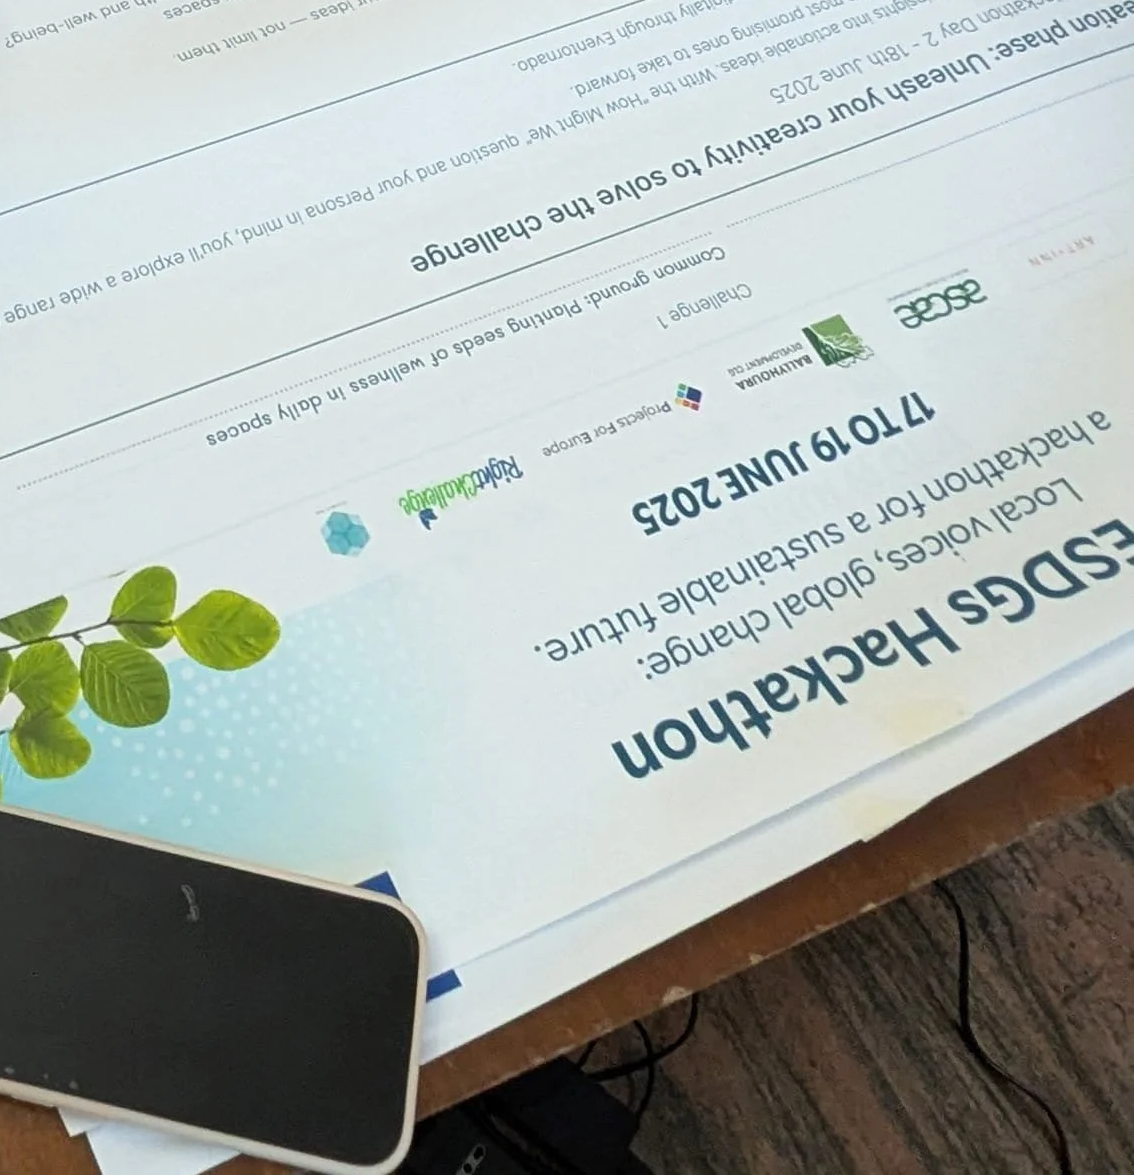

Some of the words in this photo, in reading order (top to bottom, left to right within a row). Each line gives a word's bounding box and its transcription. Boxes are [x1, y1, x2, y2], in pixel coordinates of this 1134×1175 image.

[99, 0, 131, 20] and
[615, 10, 678, 40] through
[939, 16, 979, 39] Day
[4, 11, 98, 49] well-being?
[921, 31, 940, 48] 2
[987, 18, 1070, 61] phase:
[511, 30, 617, 72] Eventornado.
[866, 43, 911, 66] 18th
[818, 57, 864, 83] June
[883, 53, 991, 102] Unleash
[769, 74, 820, 105] 2025
[827, 86, 886, 124] your
[704, 114, 822, 169] creativity
[671, 158, 702, 179] to
[596, 169, 668, 206] solve
[546, 197, 595, 224] the
[410, 215, 543, 273] challenge
[652, 246, 726, 279] Common
[583, 269, 651, 310] ground:
[668, 283, 753, 322] Challenge
[893, 278, 988, 329] ascae
[506, 299, 583, 334] Planting
[656, 315, 669, 330] 1
[430, 348, 449, 368] of
[452, 327, 506, 357] seeds
[348, 357, 426, 393] wellness
[734, 354, 814, 391] BALLYHOURA
[277, 395, 323, 422] daily
[325, 386, 347, 401] in
[900, 391, 936, 428] 17
[205, 412, 273, 446] spaces
[593, 421, 618, 438] For
[616, 400, 673, 428] Projects
[847, 406, 904, 446] TO
[1086, 410, 1112, 431] a
[542, 431, 593, 457] Europe
[810, 426, 852, 463] 19
[921, 420, 1095, 502] hackathon
[715, 440, 809, 501] JUNE
[631, 476, 723, 536] 2025
[846, 511, 872, 534] a
[876, 490, 926, 525] for
[989, 477, 1084, 534] Local
[873, 516, 993, 572] voices,
[657, 522, 845, 616] sustainable
[772, 557, 876, 630] global
[533, 601, 658, 662] future.
[637, 609, 771, 681] change:
[611, 607, 962, 779] Hackathon
